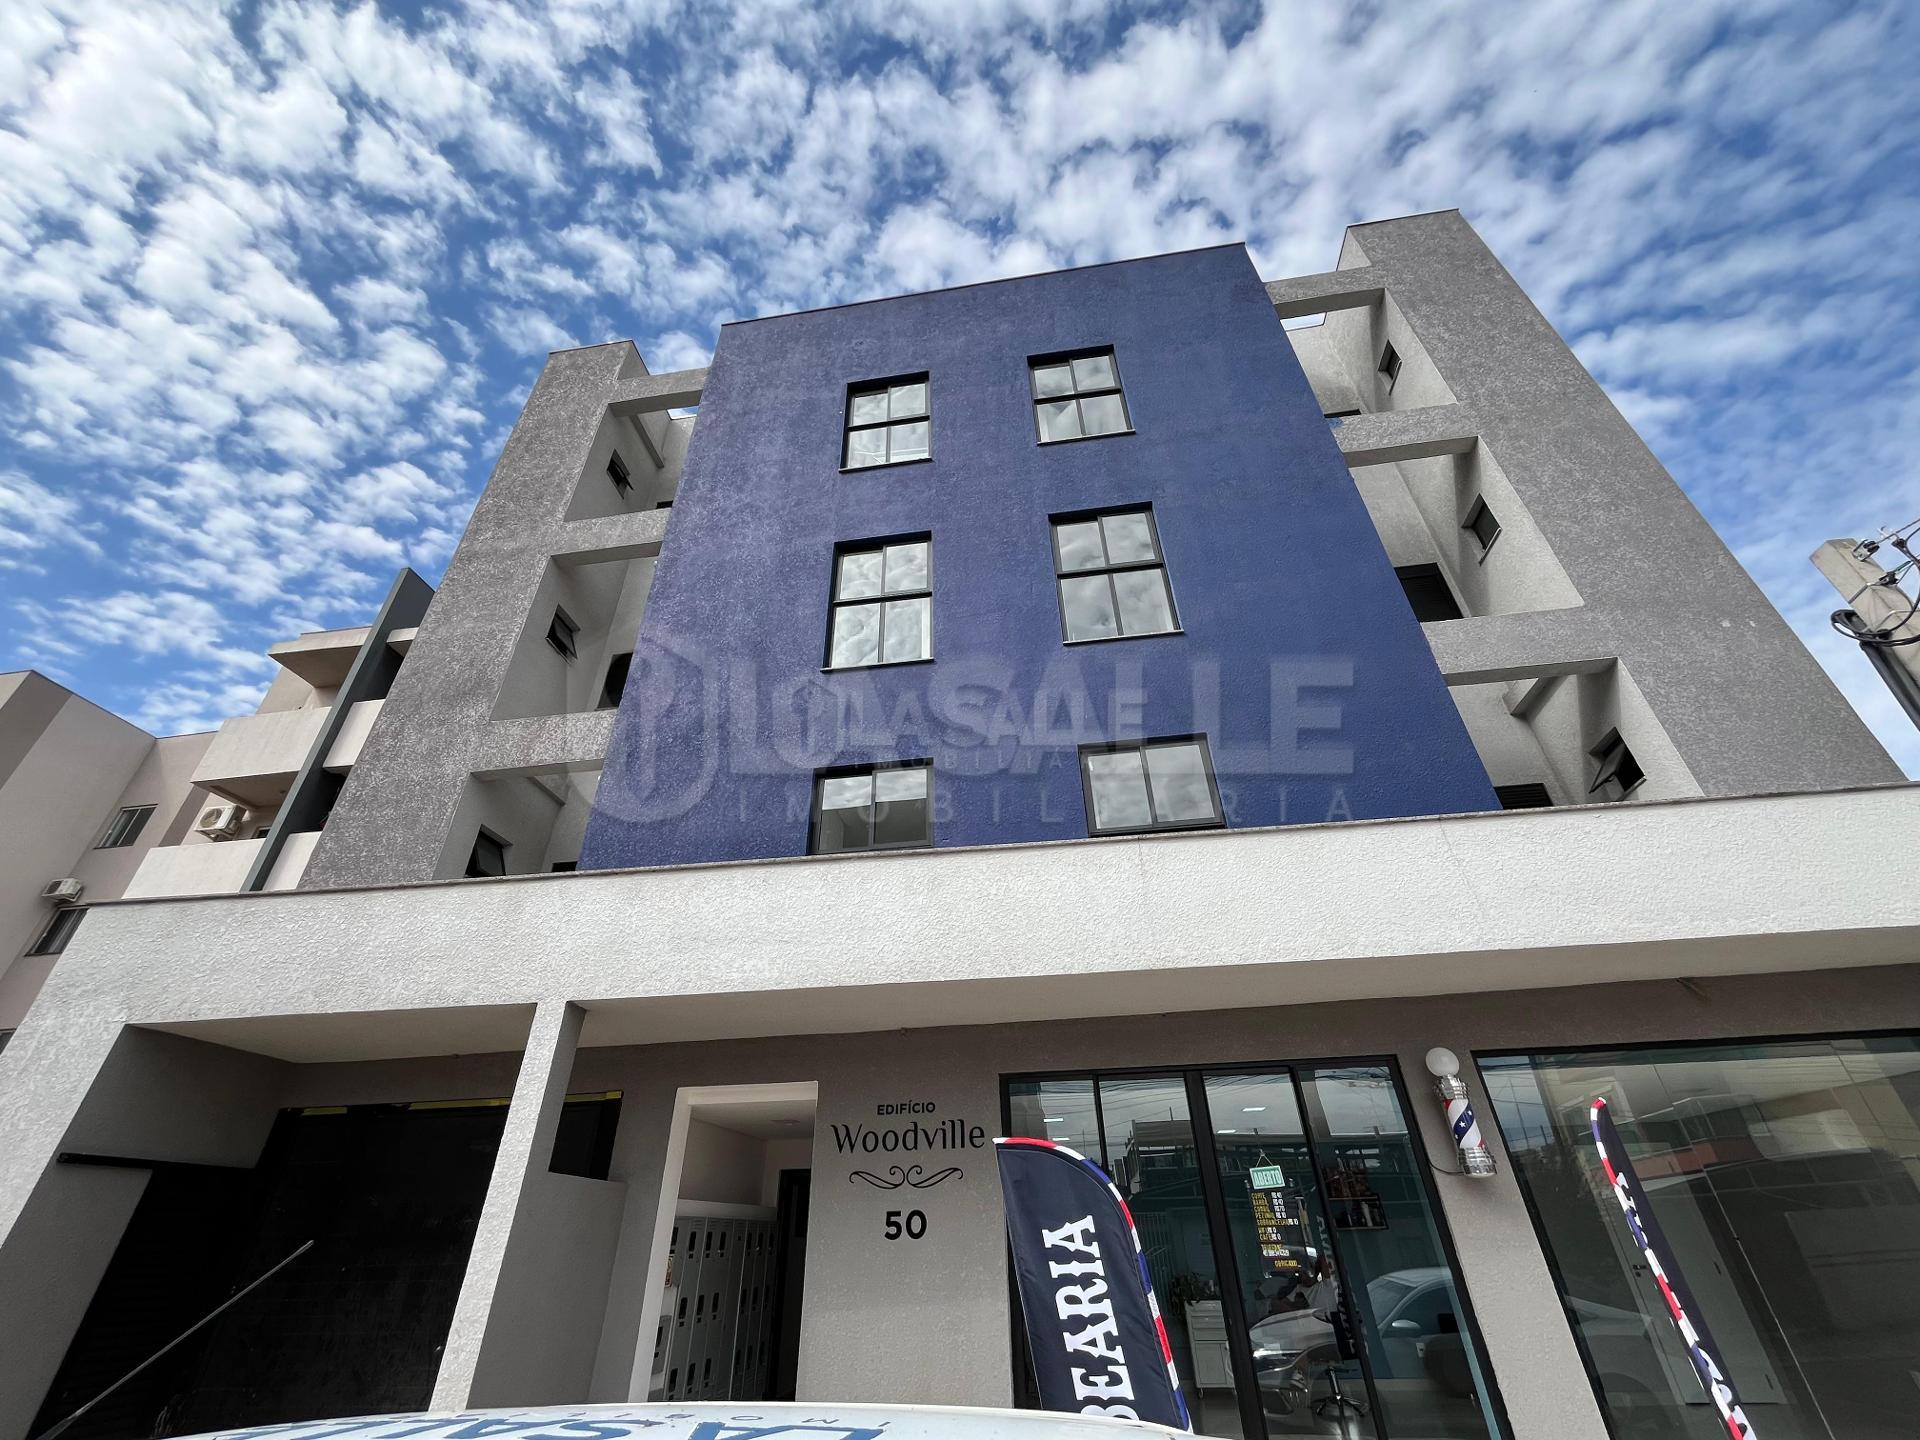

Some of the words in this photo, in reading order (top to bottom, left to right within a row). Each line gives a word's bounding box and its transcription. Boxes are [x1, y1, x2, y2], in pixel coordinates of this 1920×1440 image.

[876, 1100, 936, 1116] EDIFÍCIO
[831, 1119, 986, 1153] Woodville
[1253, 1169, 1282, 1186] ABERTO
[884, 1209, 927, 1240] 50
